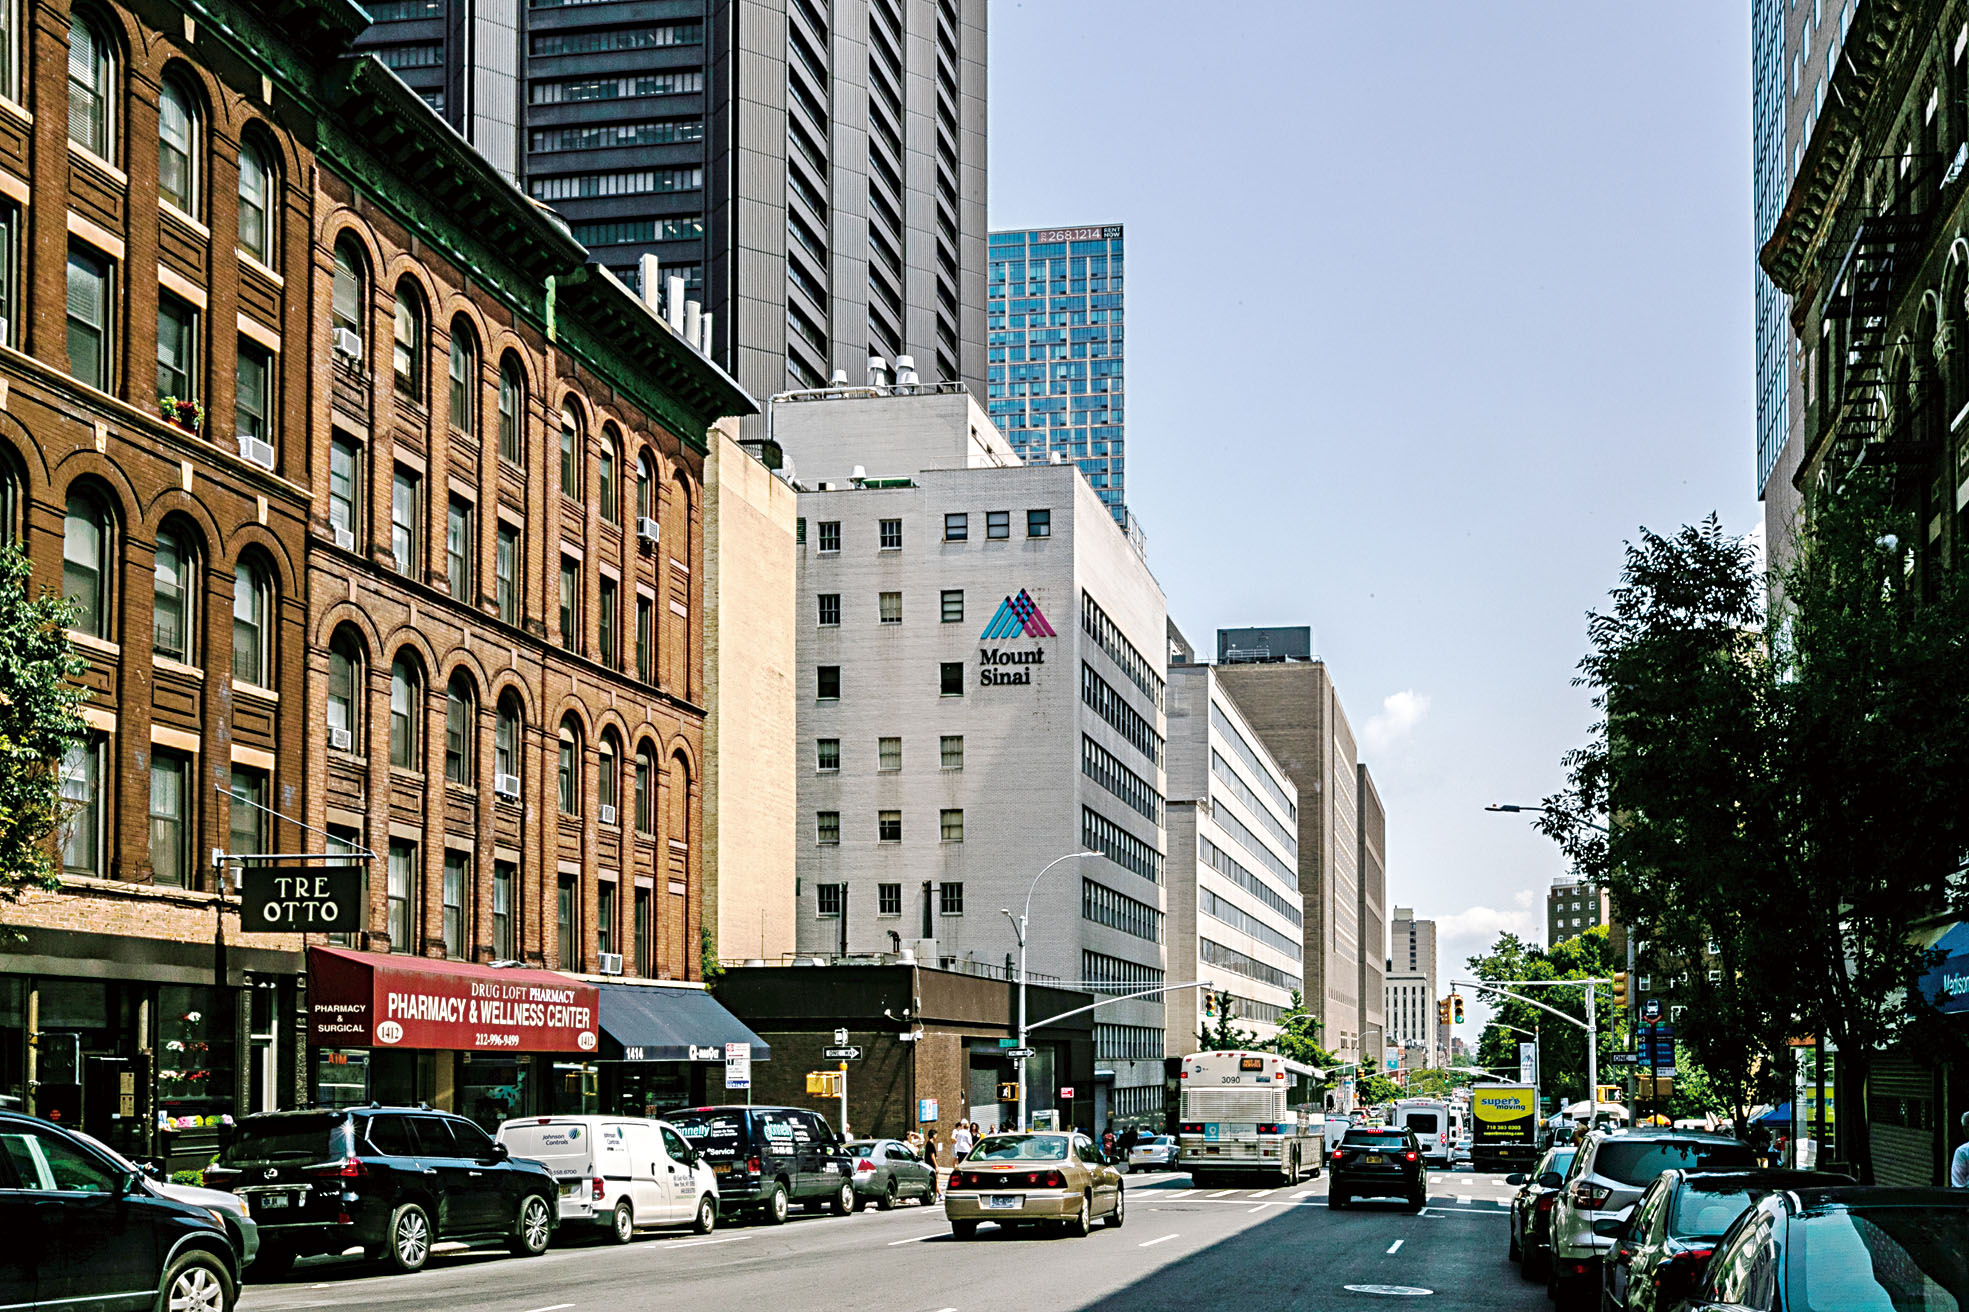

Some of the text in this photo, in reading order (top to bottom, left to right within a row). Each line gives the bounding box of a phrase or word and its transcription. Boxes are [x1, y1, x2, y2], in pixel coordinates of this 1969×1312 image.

[1048, 229, 1101, 241] 268.1214
[979, 647, 1045, 666] Mount
[980, 666, 1031, 686] Sinai
[274, 877, 331, 898] TRE
[263, 901, 339, 922] OTTO
[471, 983, 576, 1004] DRUG LOFT PHARMACY
[314, 1004, 366, 1013] PHARMACY
[388, 992, 591, 1029] PHARMACY & WELLNESS CENTER
[336, 1014, 343, 1023] &
[318, 1024, 365, 1033] SURGICAL
[381, 1026, 400, 1040] 1412
[475, 1033, 520, 1046] 212-996-9499
[580, 1036, 594, 1046] 1412
[328, 1053, 347, 1065] ATM
[626, 1047, 644, 1060] 1414
[1222, 1076, 1240, 1084] 3090
[710, 1148, 736, 1156] Service
